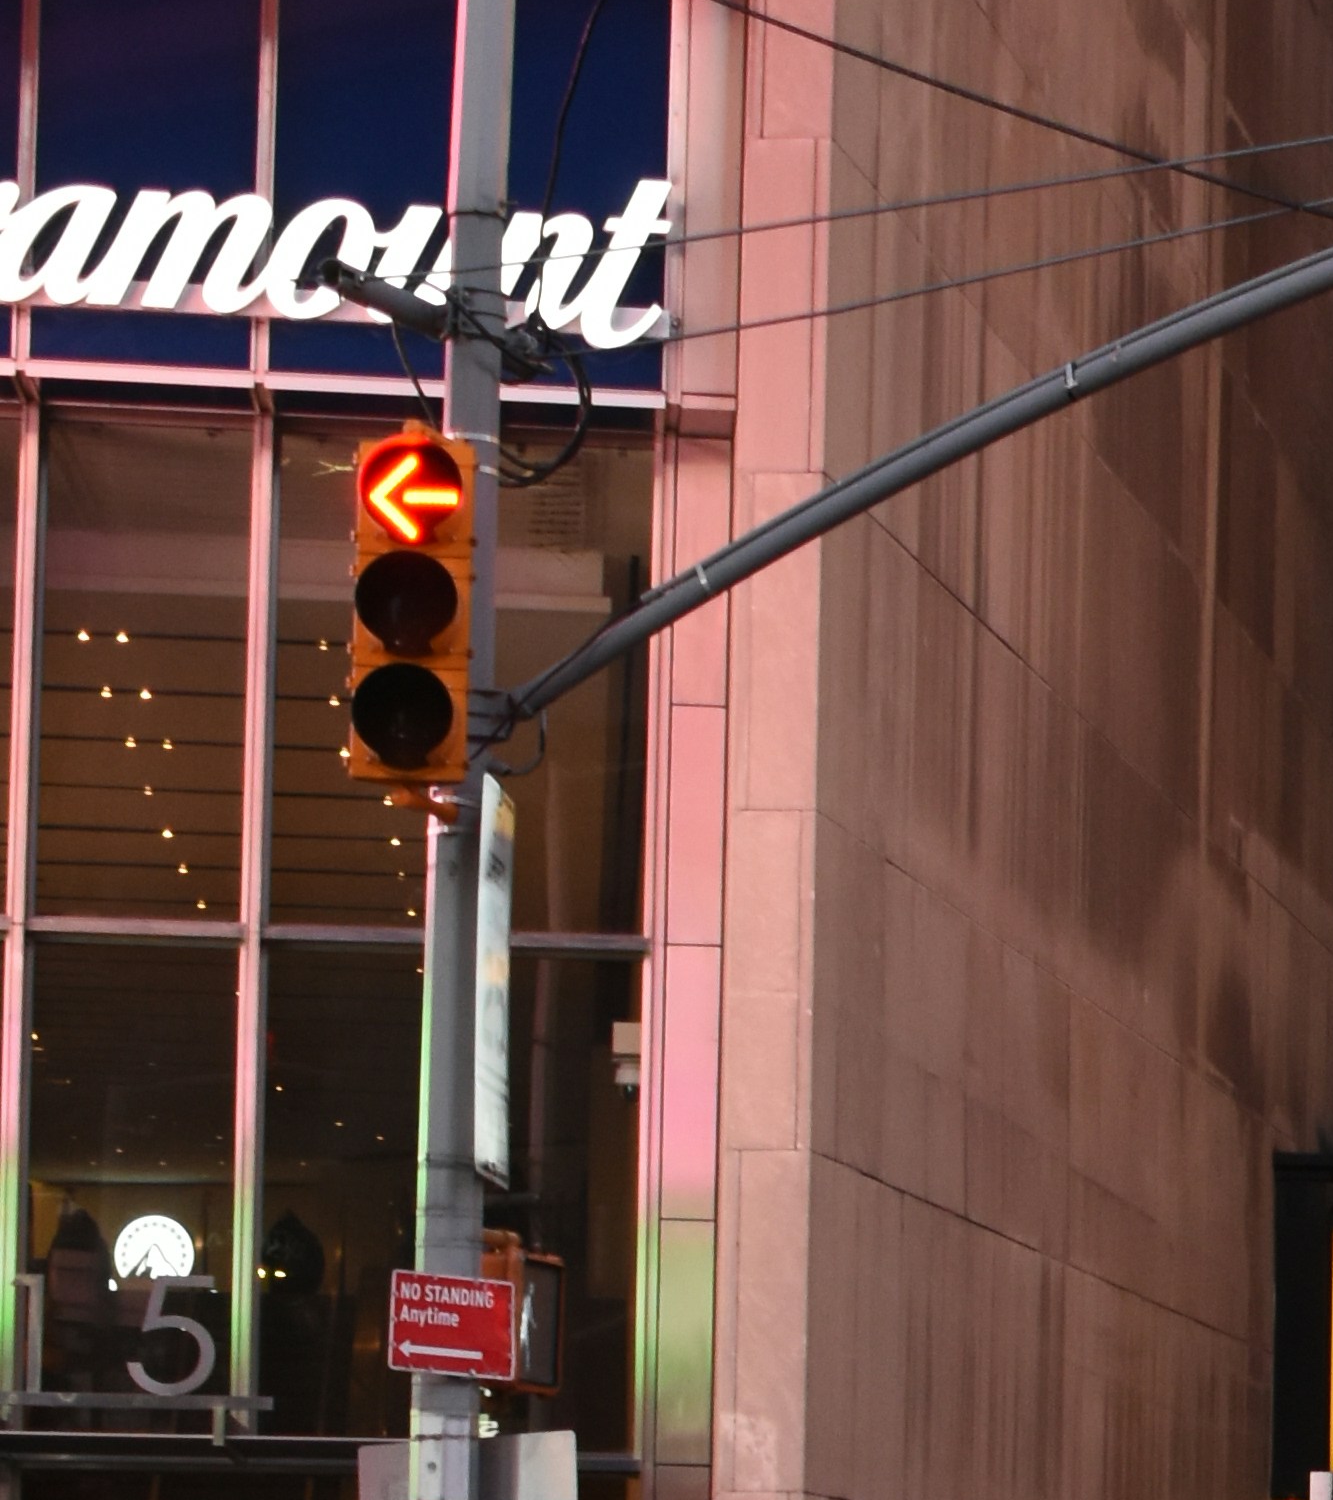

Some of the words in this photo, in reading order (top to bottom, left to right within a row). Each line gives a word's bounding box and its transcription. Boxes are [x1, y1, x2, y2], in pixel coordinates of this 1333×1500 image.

[400, 1282, 421, 1301] NO
[425, 1284, 495, 1308] STANDING
[400, 1304, 460, 1327] Anytime
